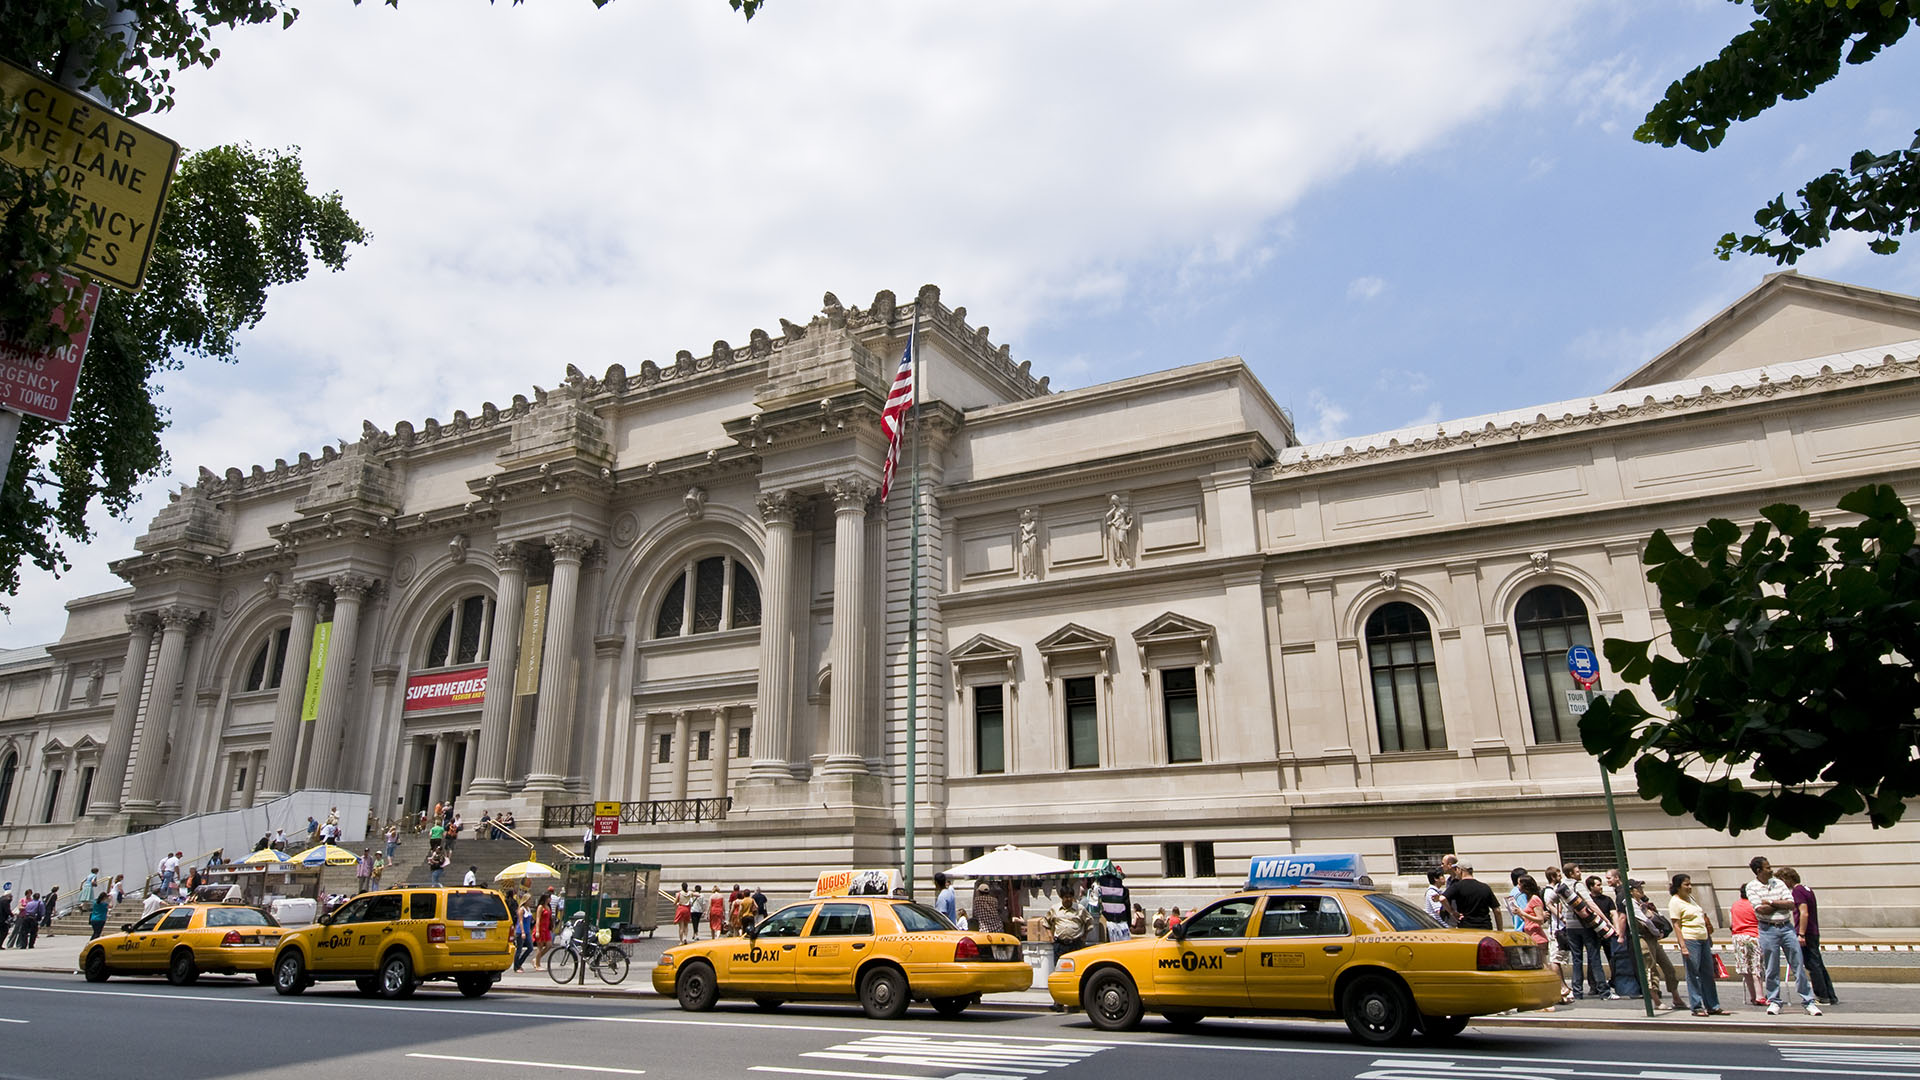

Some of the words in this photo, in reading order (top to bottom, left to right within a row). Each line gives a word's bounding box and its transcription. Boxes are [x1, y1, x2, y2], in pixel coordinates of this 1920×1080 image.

[24, 88, 136, 158] CLEAR
[11, 114, 61, 156] IRE
[72, 142, 147, 194] LANE
[0, 348, 45, 372] URING
[0, 362, 60, 393] RGENCY
[20, 387, 58, 411] TOWED
[406, 678, 487, 700] SUPERHEROES
[1570, 704, 1587, 712] TOUR
[1255, 860, 1316, 878] Milan
[330, 935, 351, 949] TAXI
[732, 953, 750, 961] NYC
[750, 948, 780, 962] TAXI
[1158, 958, 1181, 969] NYC
[1182, 951, 1223, 970] TAXI
